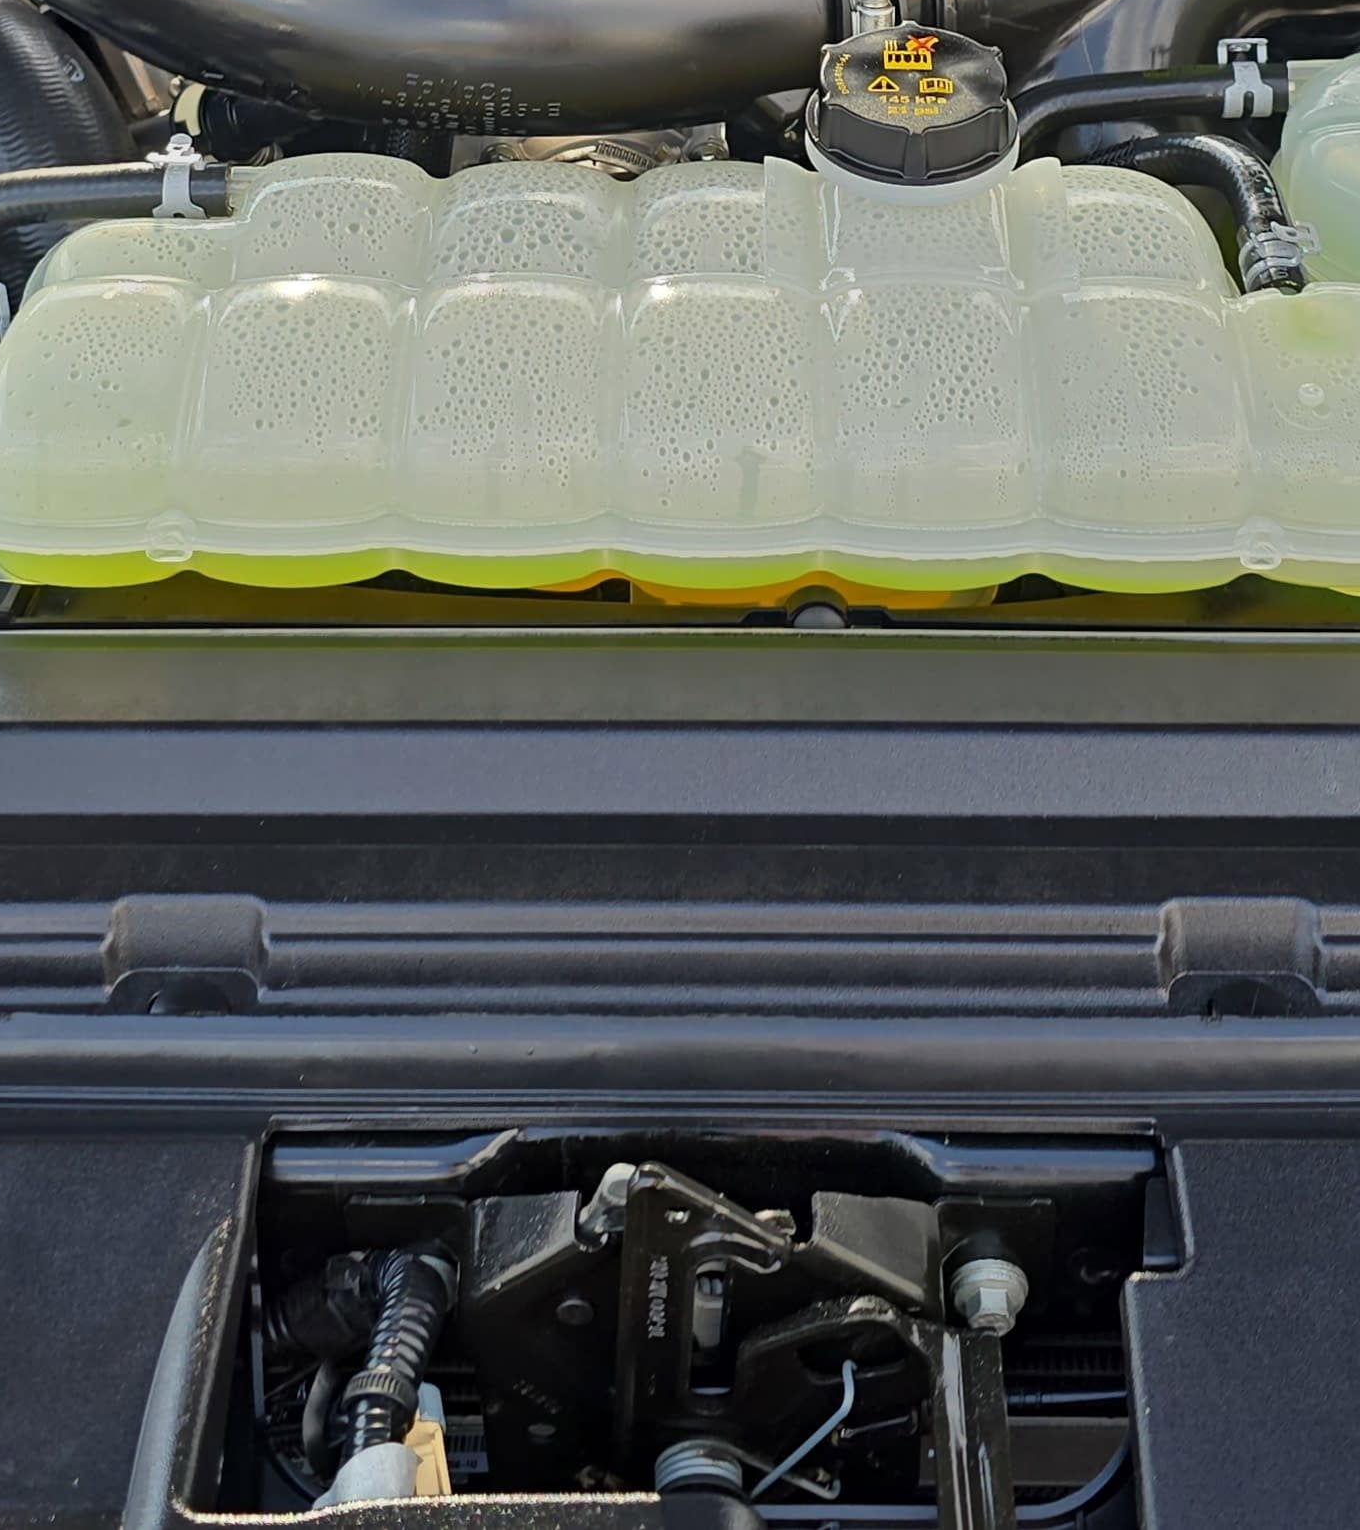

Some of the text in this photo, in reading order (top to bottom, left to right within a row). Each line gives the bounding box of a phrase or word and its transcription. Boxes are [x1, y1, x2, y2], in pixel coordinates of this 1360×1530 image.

[879, 95, 947, 104] 145 kPa
[887, 106, 941, 117] 21 psi
